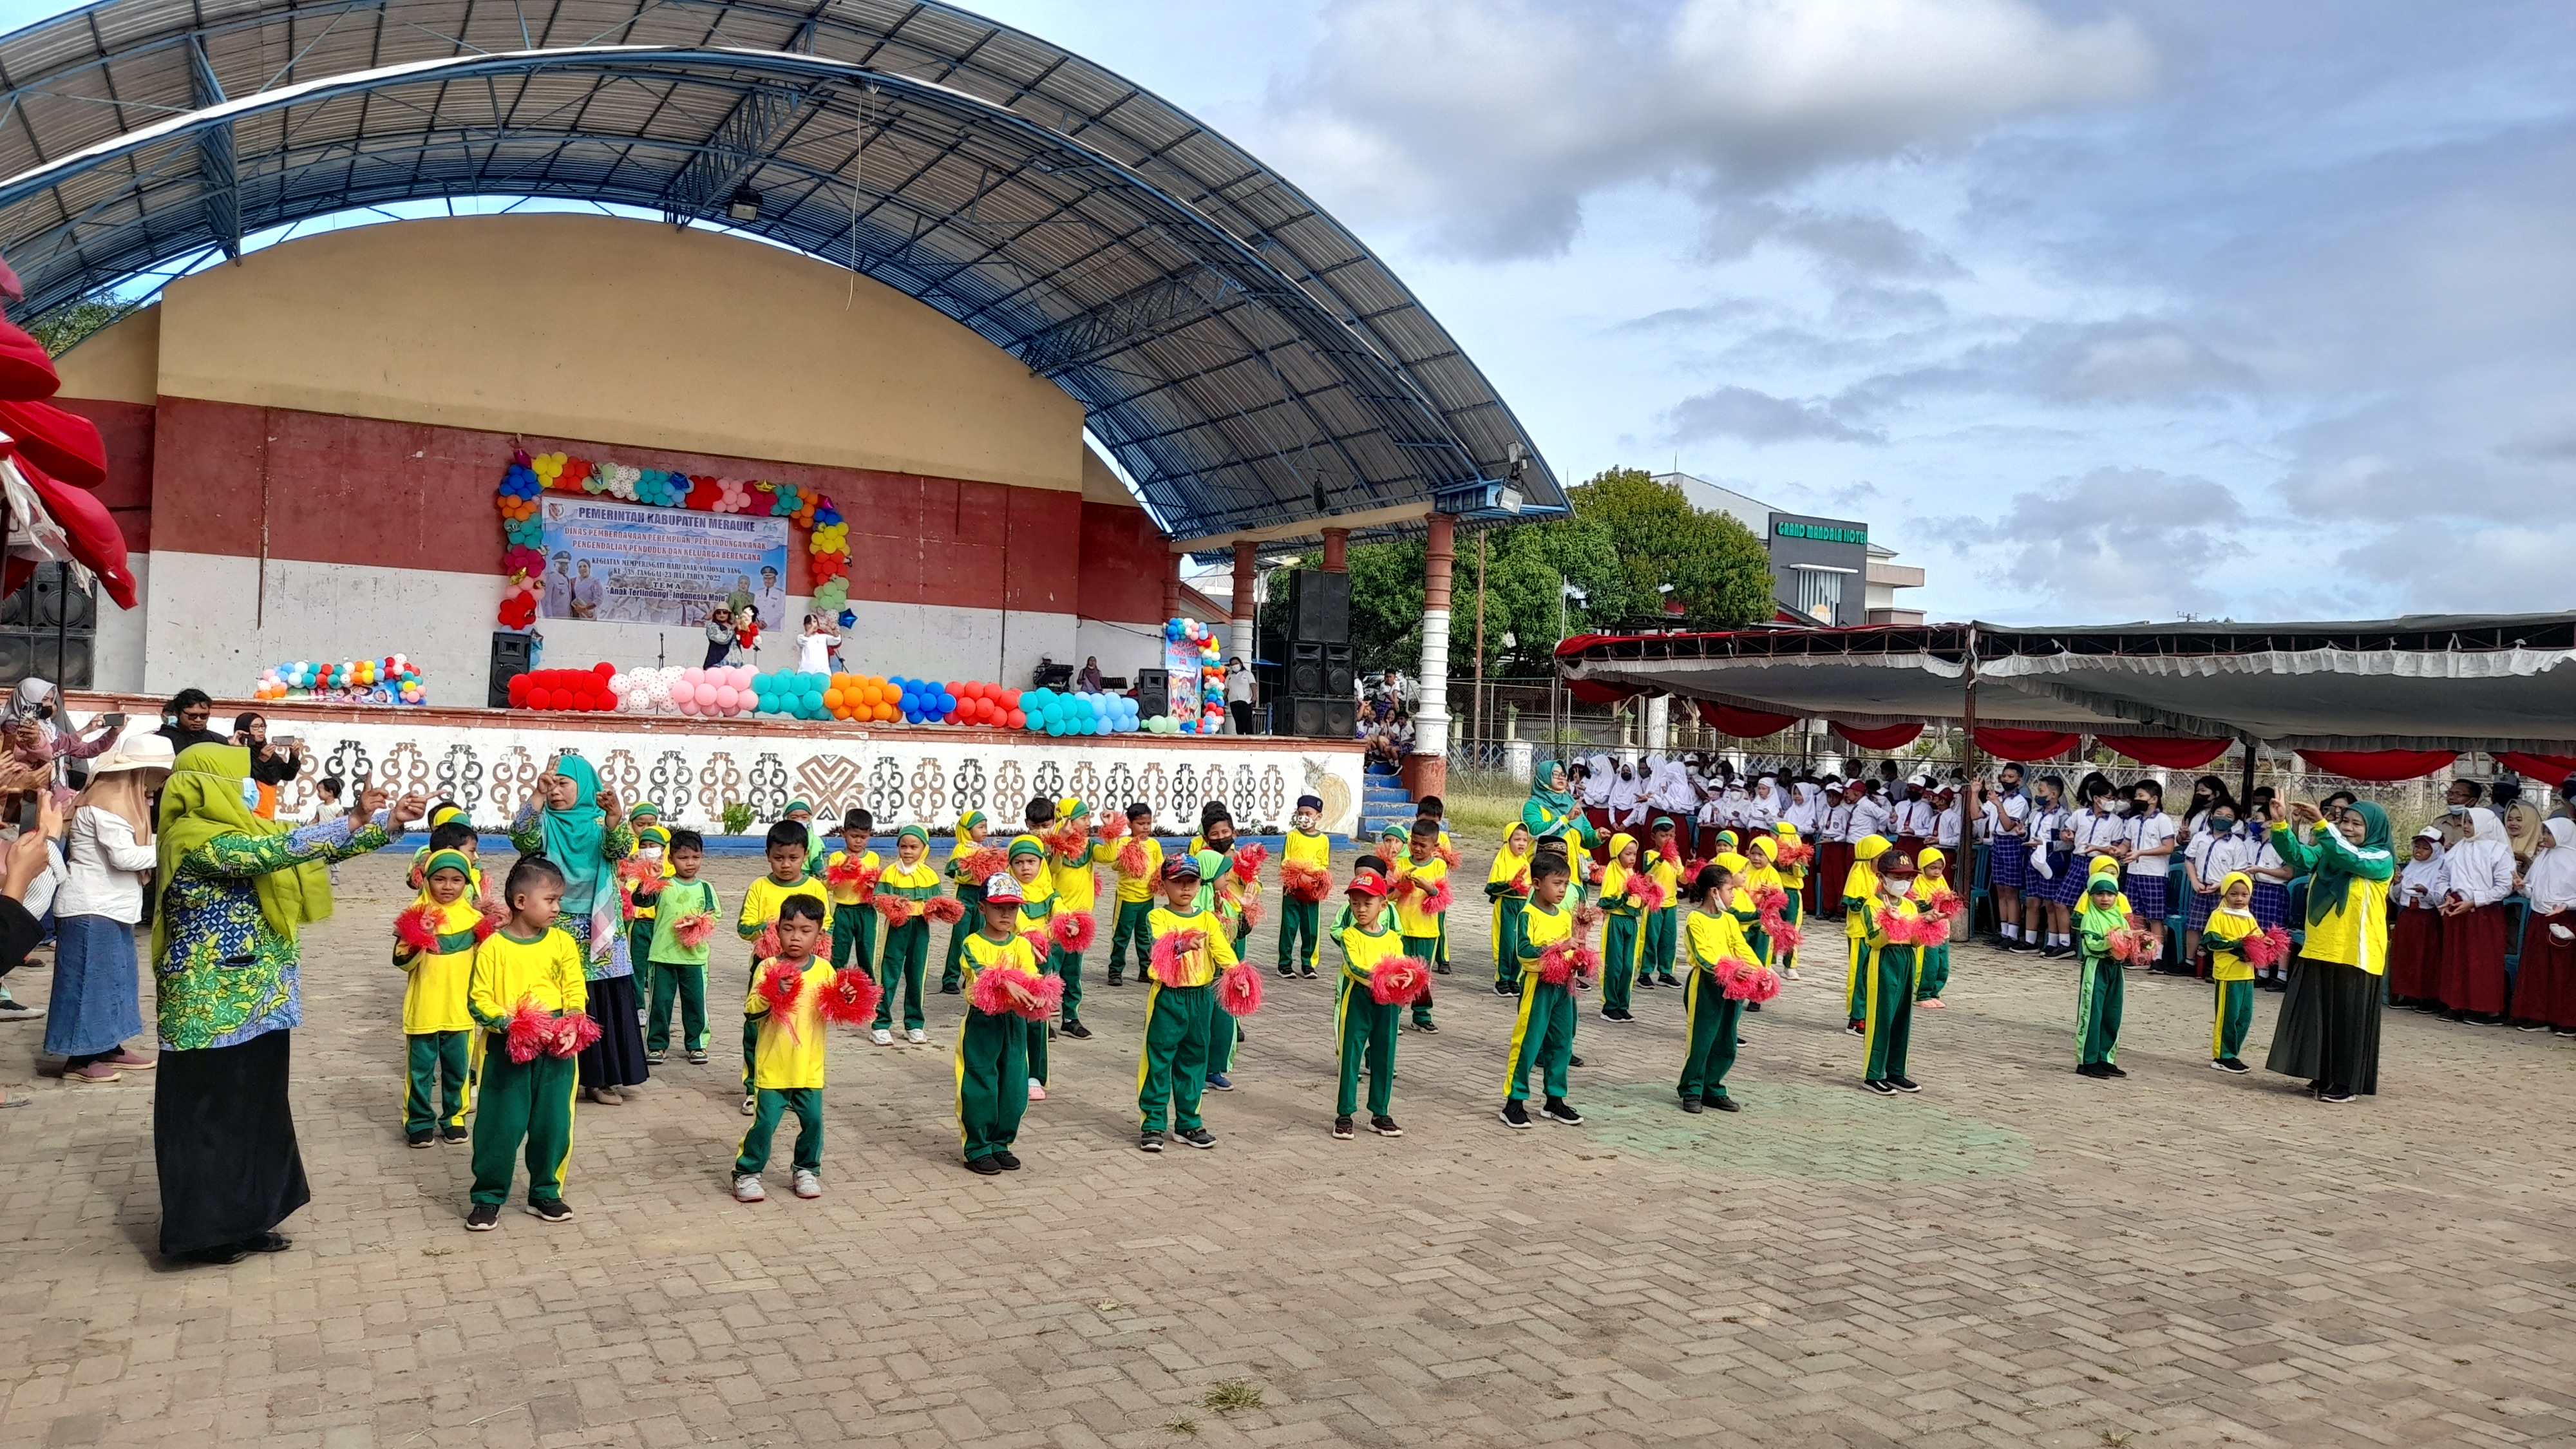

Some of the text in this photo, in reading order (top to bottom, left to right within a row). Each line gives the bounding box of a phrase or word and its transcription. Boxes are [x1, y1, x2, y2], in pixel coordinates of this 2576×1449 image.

[578, 507, 755, 532] PEMERINTAH KABUPATEN MERAUKE
[565, 527, 587, 536] DINAS
[589, 529, 647, 540] PEMBERDAYAAN
[1777, 521, 1867, 545] GRAND MANDALA HOTEL
[573, 540, 627, 551] PENGENDALIAN
[592, 557, 620, 565] KEGIATAN
[652, 582, 681, 590] TEMA
[673, 592, 707, 601] Indonesia
